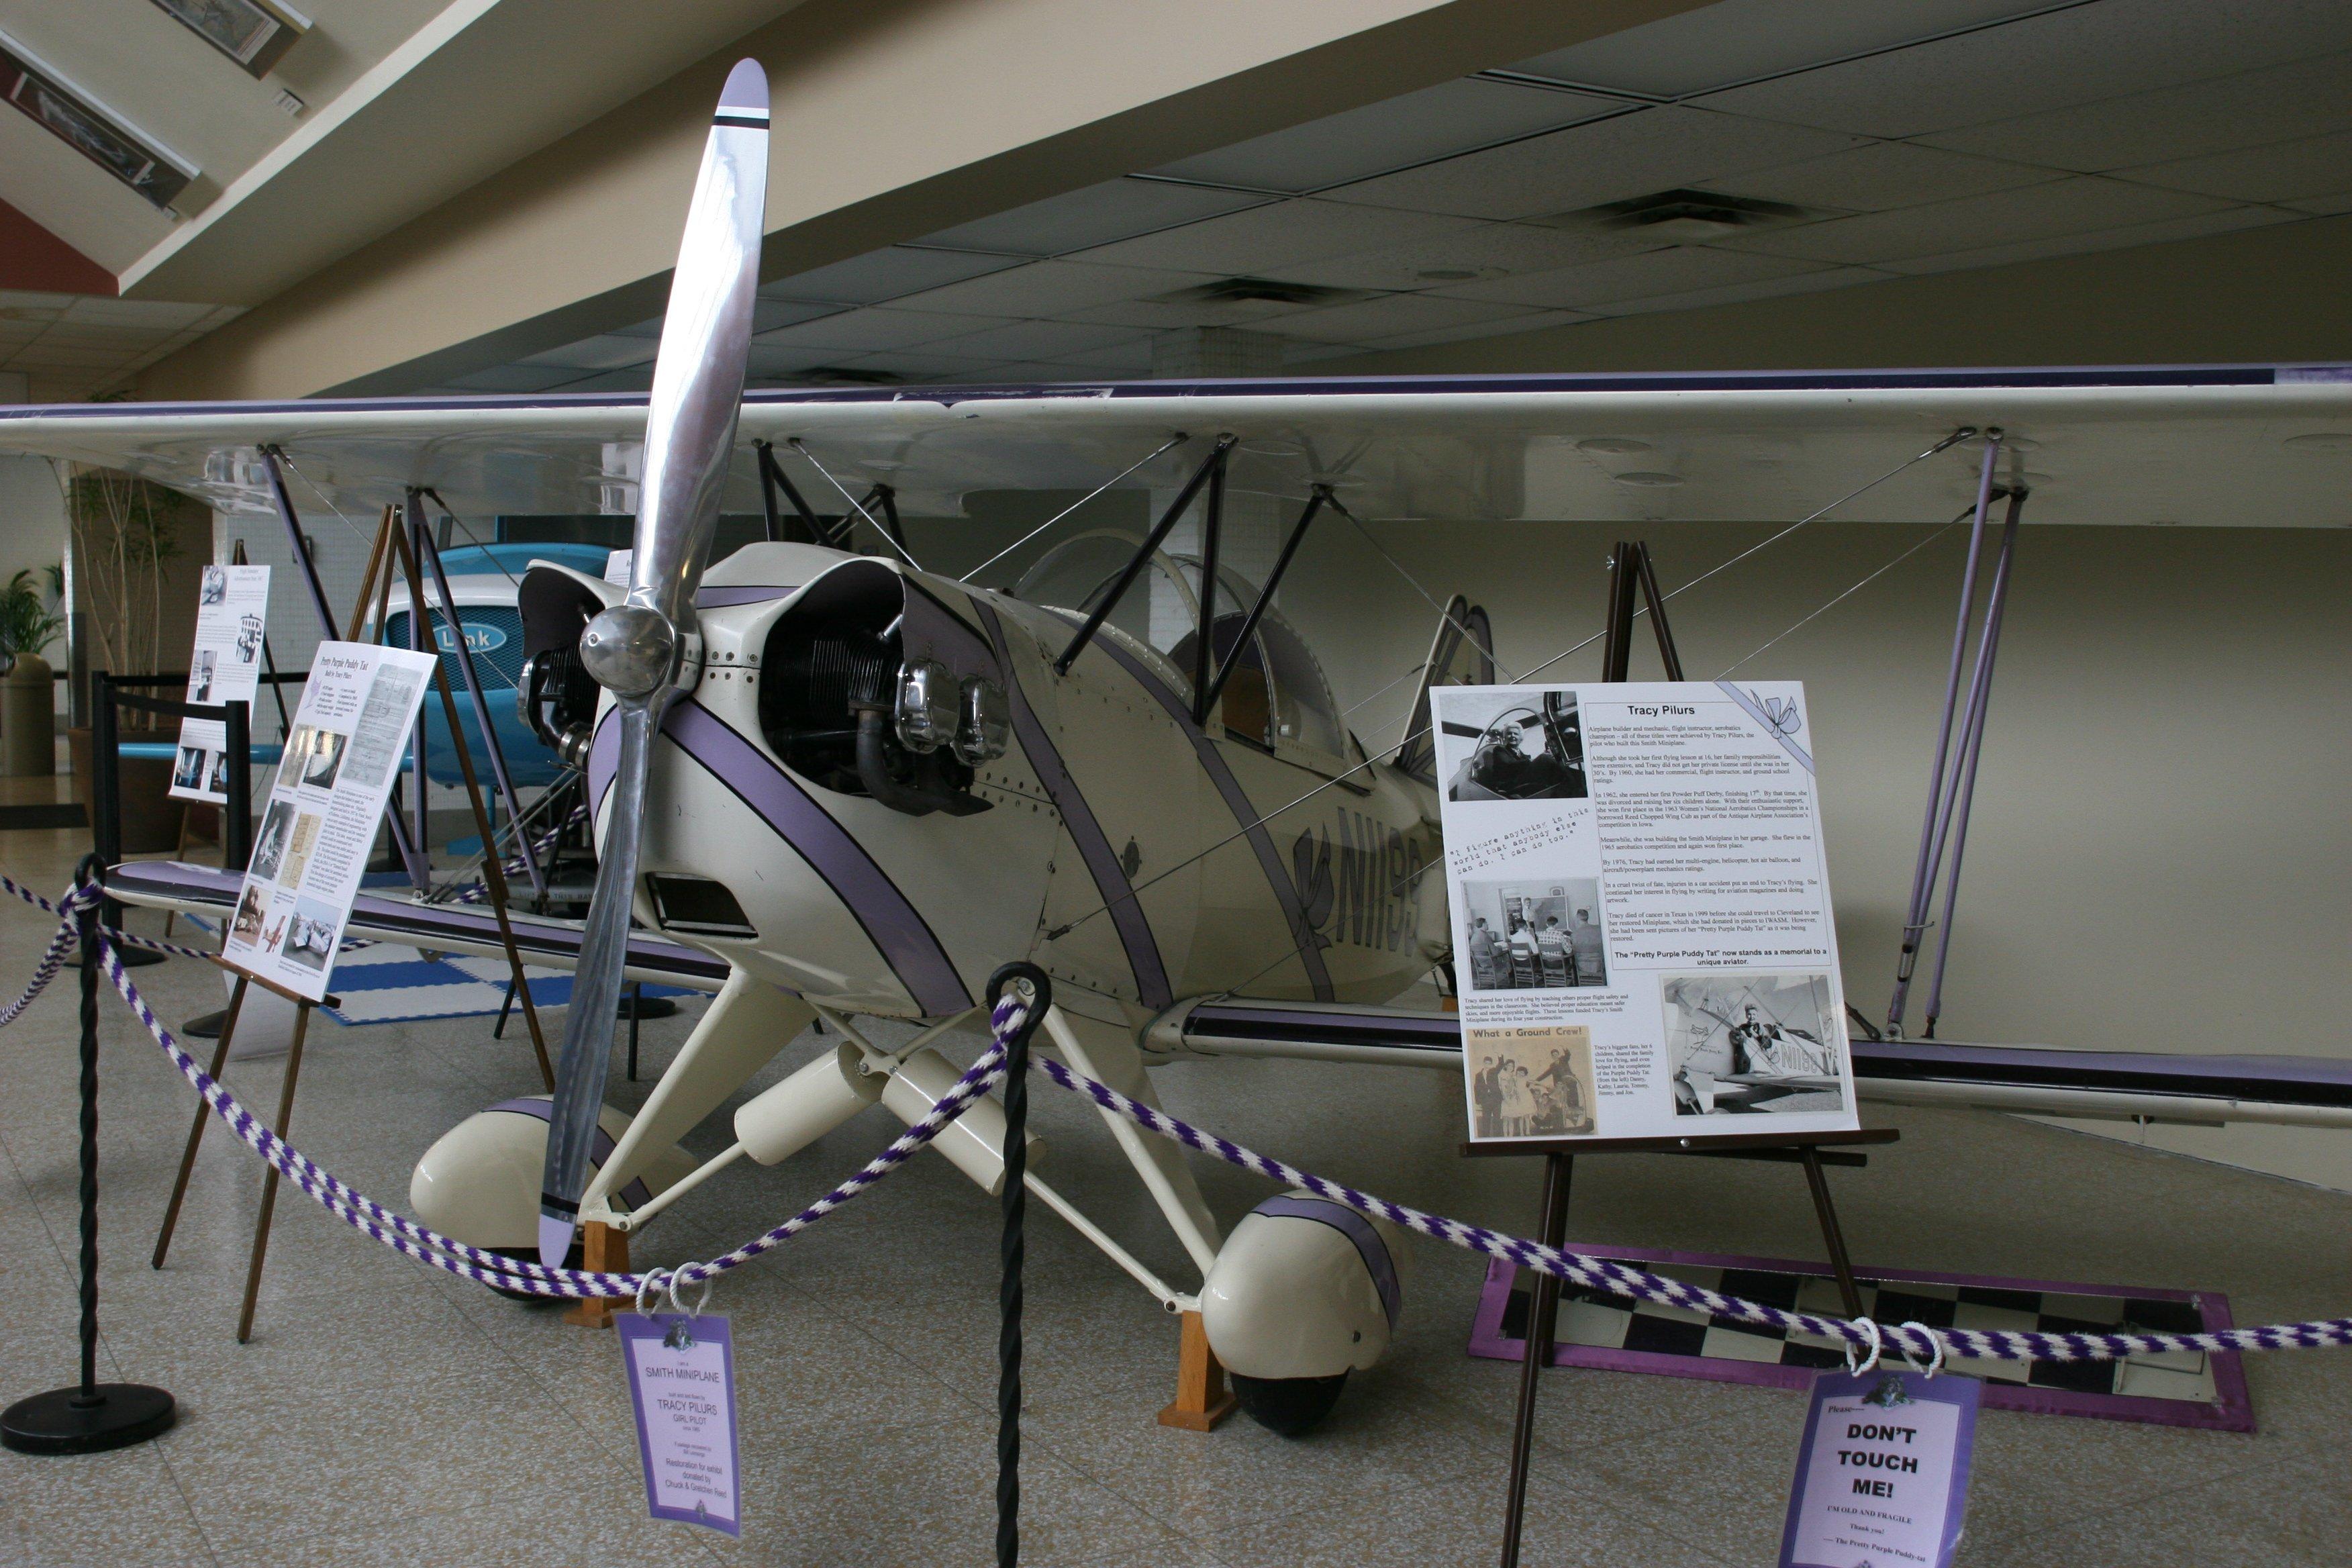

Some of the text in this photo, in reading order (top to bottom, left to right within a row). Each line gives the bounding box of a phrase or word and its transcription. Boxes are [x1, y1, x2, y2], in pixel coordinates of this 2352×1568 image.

[443, 630, 490, 646] Lnk
[1628, 705, 1696, 717] Tracy Pilurs
[1555, 822, 1577, 832] else
[1457, 865, 1473, 875] can
[1511, 847, 1527, 856] can
[646, 1367, 720, 1383] SMITH MINIPLANE
[657, 1400, 717, 1415] TRACY PILURS
[673, 1414, 706, 1424] GIRL PILOT
[1847, 1423, 1917, 1444] DON'T
[666, 1458, 698, 1469] Restoration
[1838, 1450, 1918, 1473] TOUCH
[665, 1479, 683, 1488] Chuck
[683, 1471, 710, 1485] donated by
[1853, 1478, 1894, 1498] ME!
[1841, 1506, 1858, 1514] OLD
[1860, 1509, 1876, 1517] AND
[1877, 1512, 1913, 1524] FRAGILE
[1850, 1523, 1869, 1532] Thank
[1835, 1537, 1848, 1545] The
[1850, 1540, 1869, 1549] Pretty
[1871, 1544, 1894, 1555] Purple
